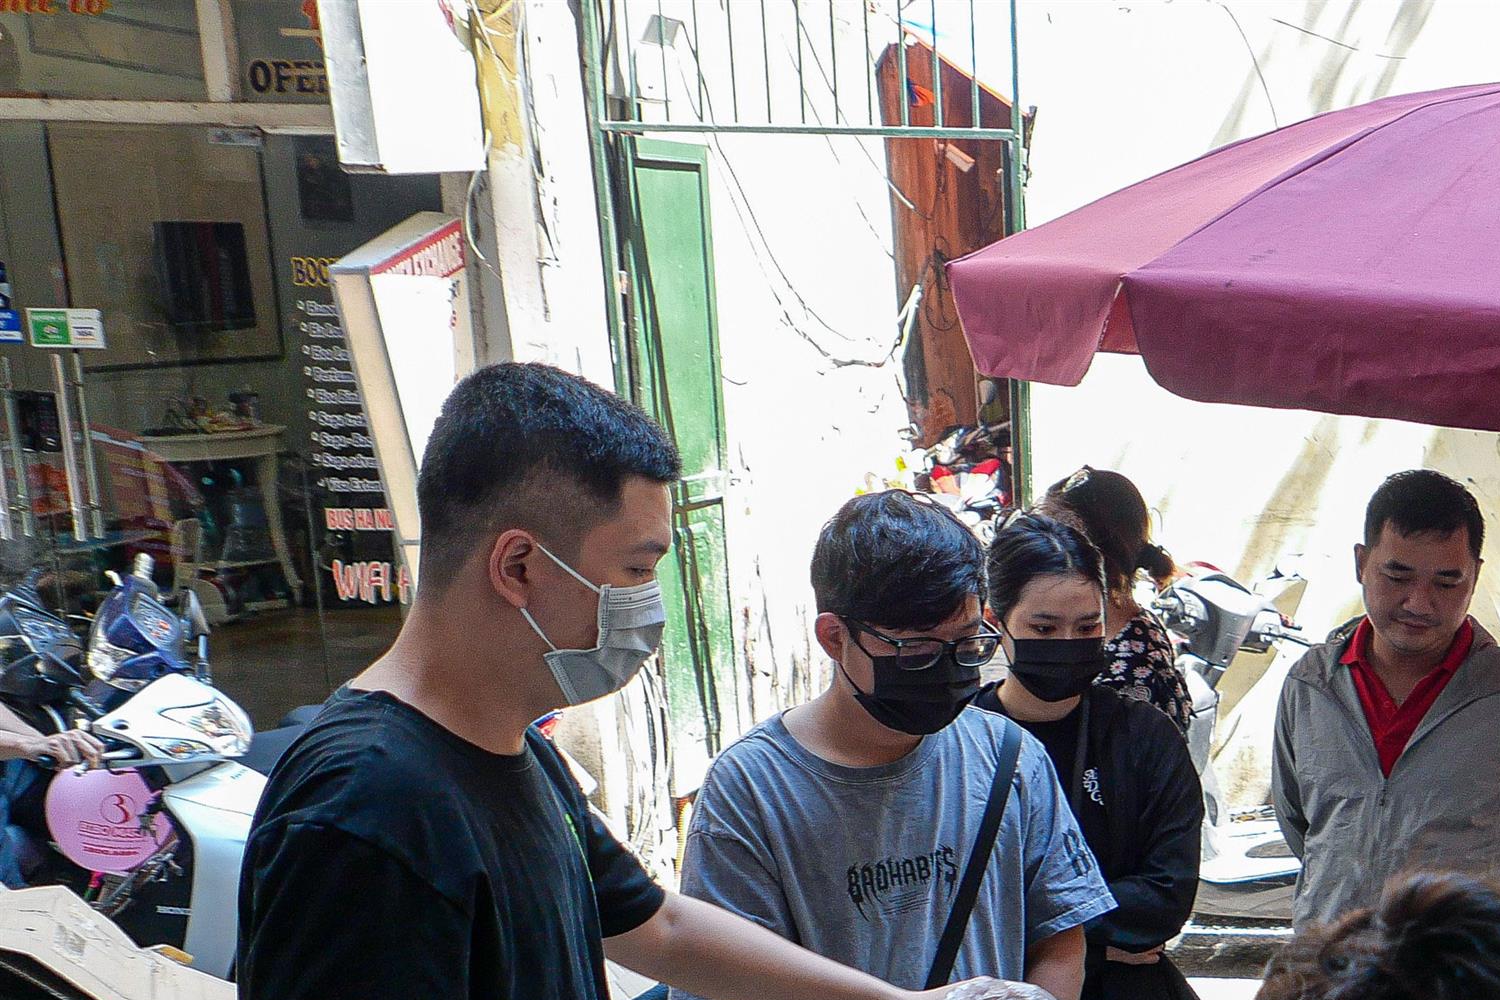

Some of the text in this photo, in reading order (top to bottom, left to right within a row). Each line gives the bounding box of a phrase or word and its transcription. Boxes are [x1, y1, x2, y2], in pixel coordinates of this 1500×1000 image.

[291, 257, 339, 287] BOO
[325, 507, 355, 531] BUS
[332, 559, 392, 604] WIFI
